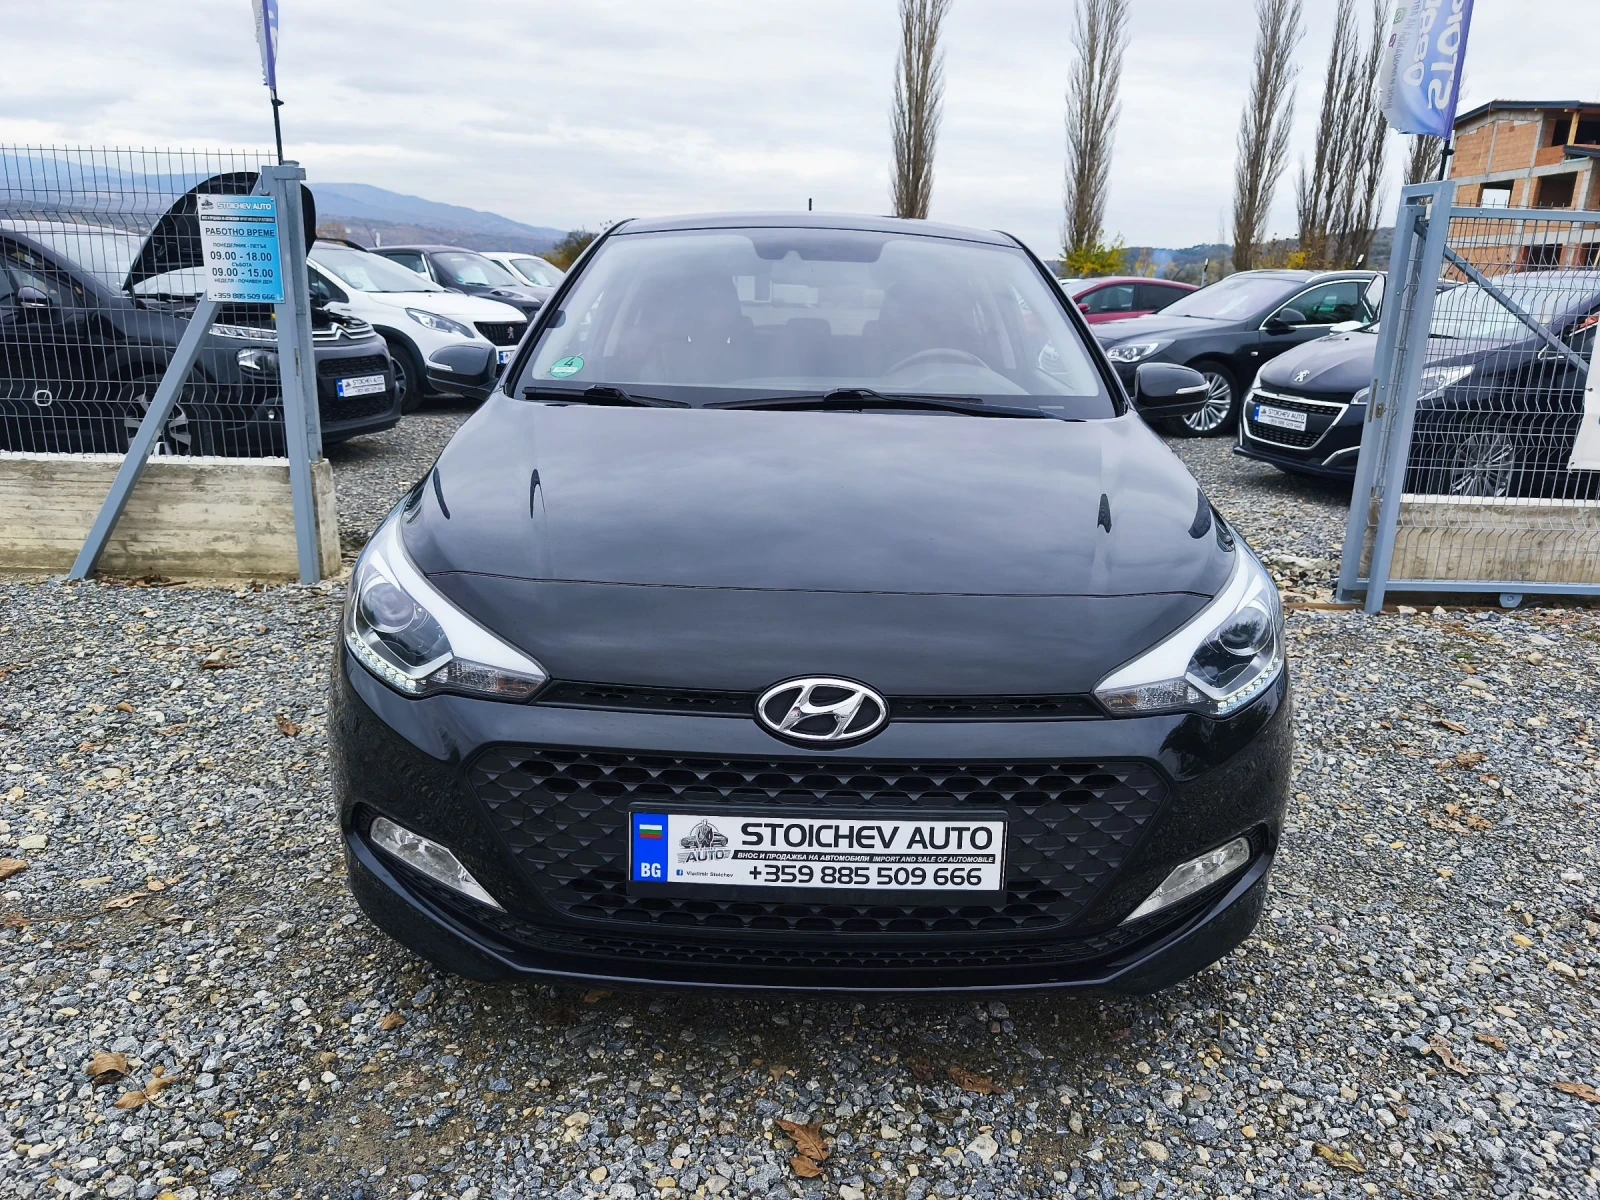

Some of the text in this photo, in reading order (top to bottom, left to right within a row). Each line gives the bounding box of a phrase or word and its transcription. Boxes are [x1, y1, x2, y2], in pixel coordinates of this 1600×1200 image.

[205, 227, 275, 237] РАБОТНО ВРЕМЕ
[210, 251, 237, 261] 09.00
[246, 252, 272, 262] 18.00
[212, 267, 238, 277] 09.00
[247, 268, 274, 278] 15.00
[564, 357, 575, 367] 4
[741, 823, 993, 850] STOICHEV AUTO
[686, 850, 725, 862] AUTO
[737, 851, 758, 859] ВНОС
[766, 853, 807, 861] ПРОДАЖБА
[641, 862, 662, 878] BG
[749, 864, 982, 886] +359 885 509 666
